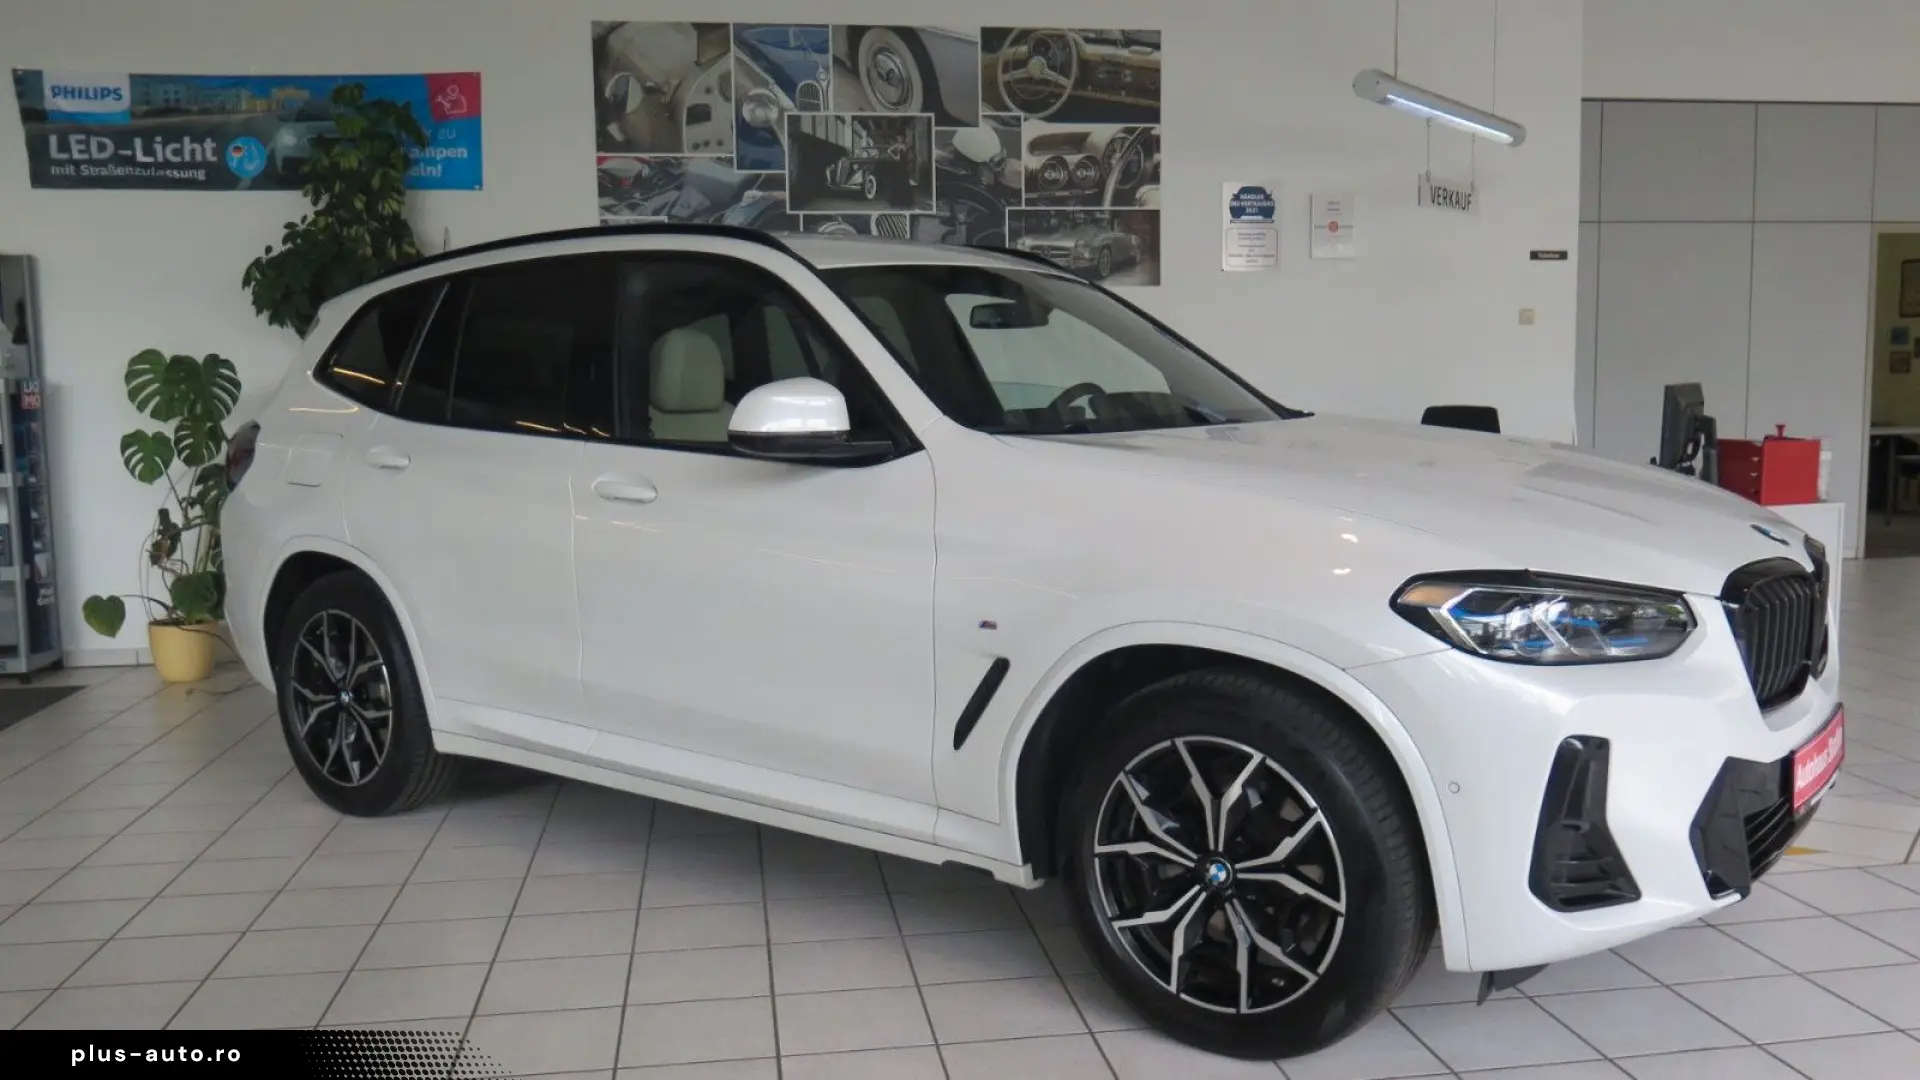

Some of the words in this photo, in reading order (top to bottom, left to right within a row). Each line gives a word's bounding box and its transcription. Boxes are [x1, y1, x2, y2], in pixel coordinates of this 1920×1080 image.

[51, 85, 123, 101] PHILIPS
[49, 134, 218, 163] LED-Licht
[408, 146, 468, 161] ampen
[51, 163, 76, 176] mit
[1430, 185, 1472, 212] VERKAUF
